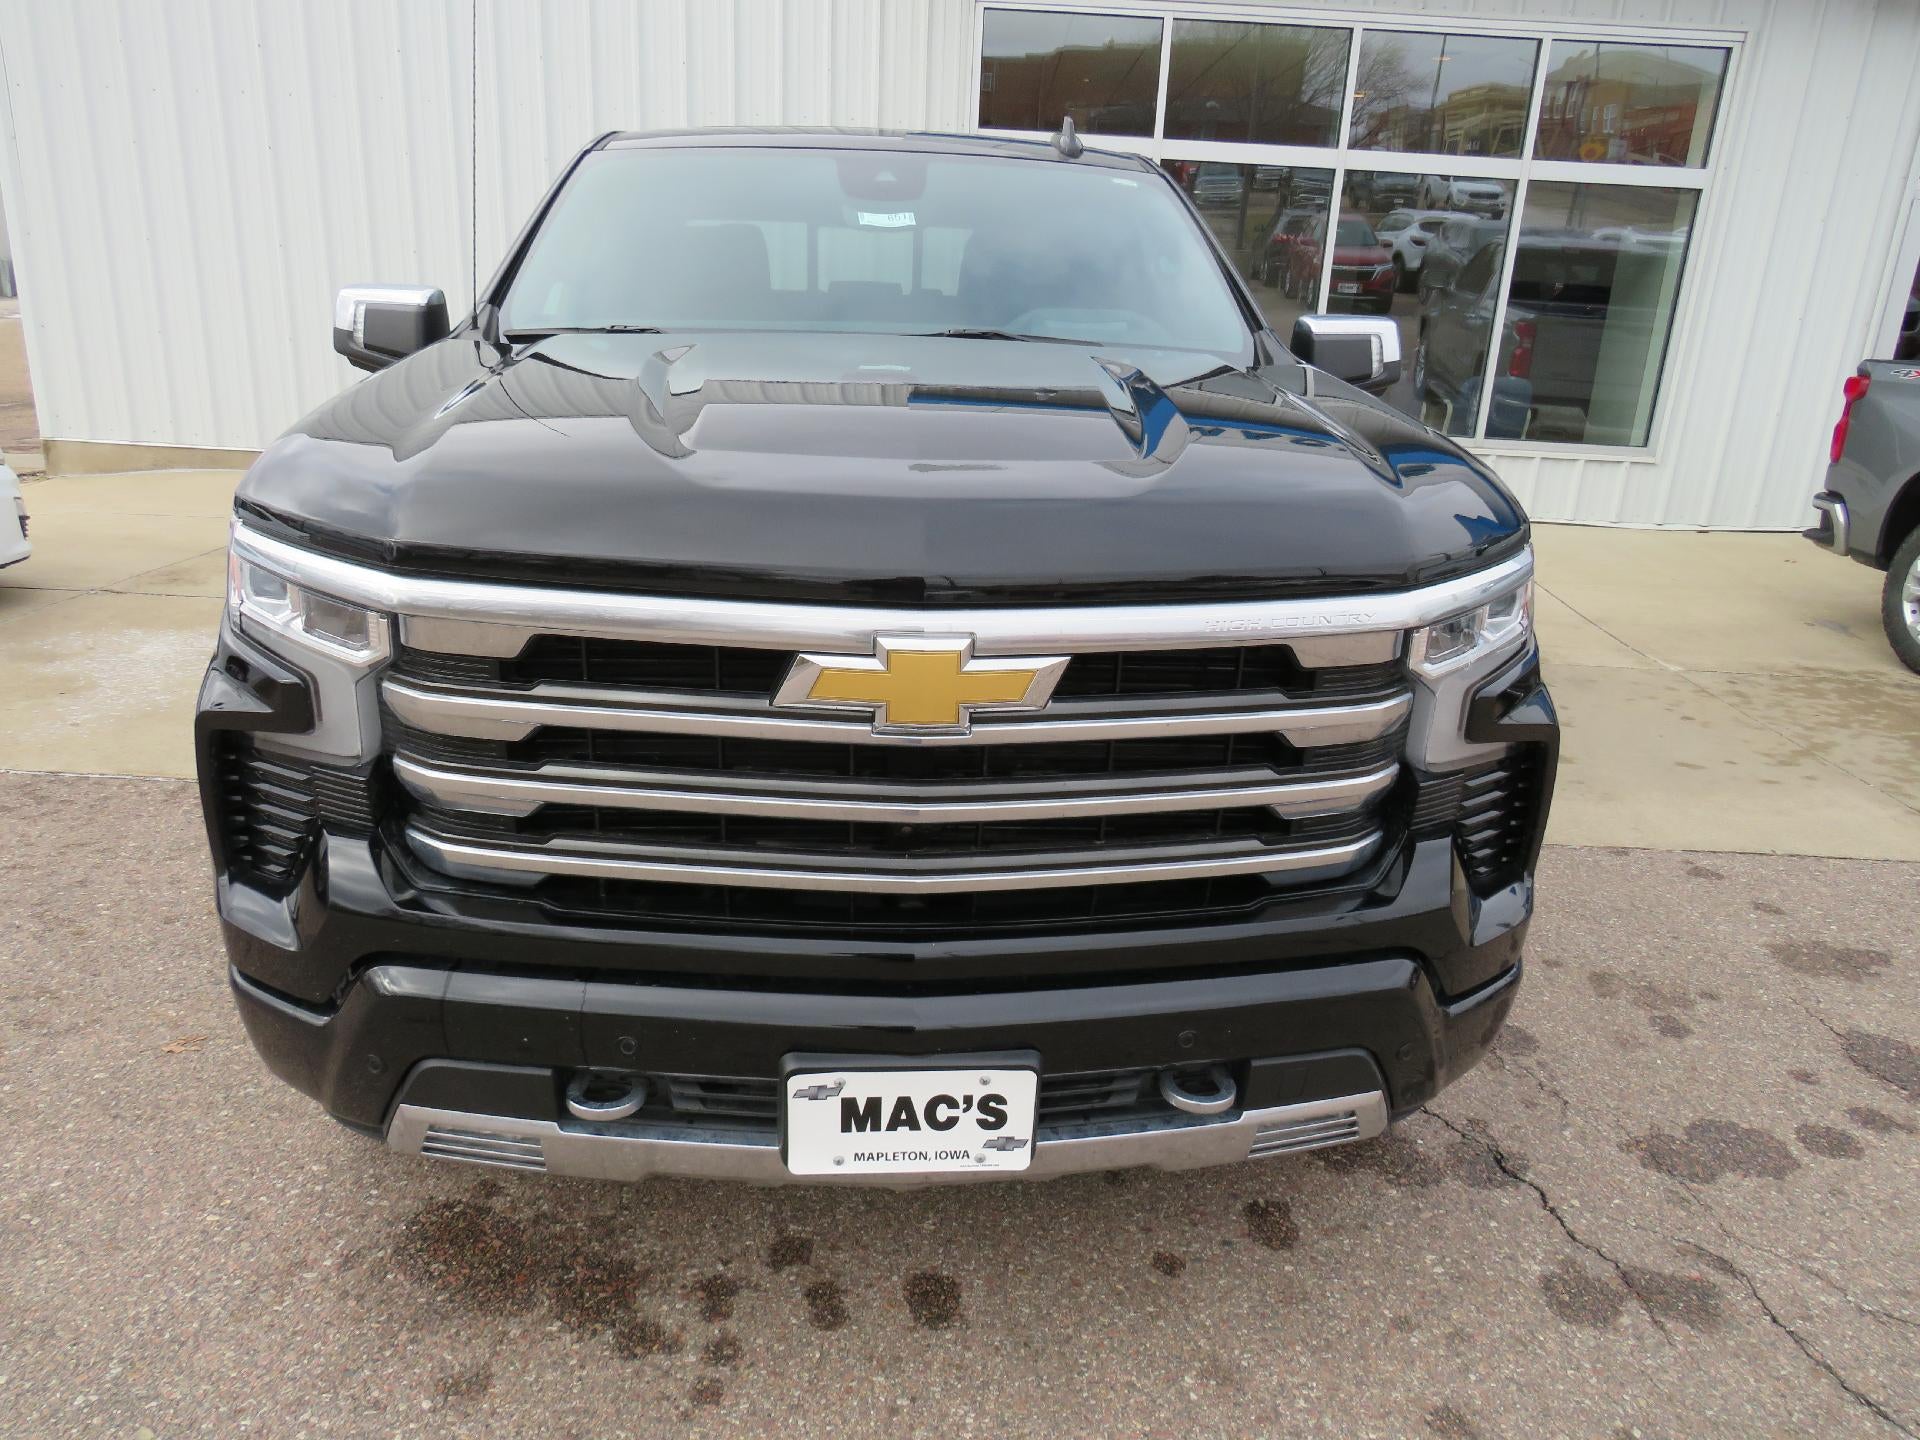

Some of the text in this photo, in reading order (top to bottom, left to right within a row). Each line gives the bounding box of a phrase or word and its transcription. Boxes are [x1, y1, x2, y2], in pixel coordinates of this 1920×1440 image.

[1205, 612, 1377, 632] HIGH COUNTRY
[840, 1093, 1008, 1133] MAC'S
